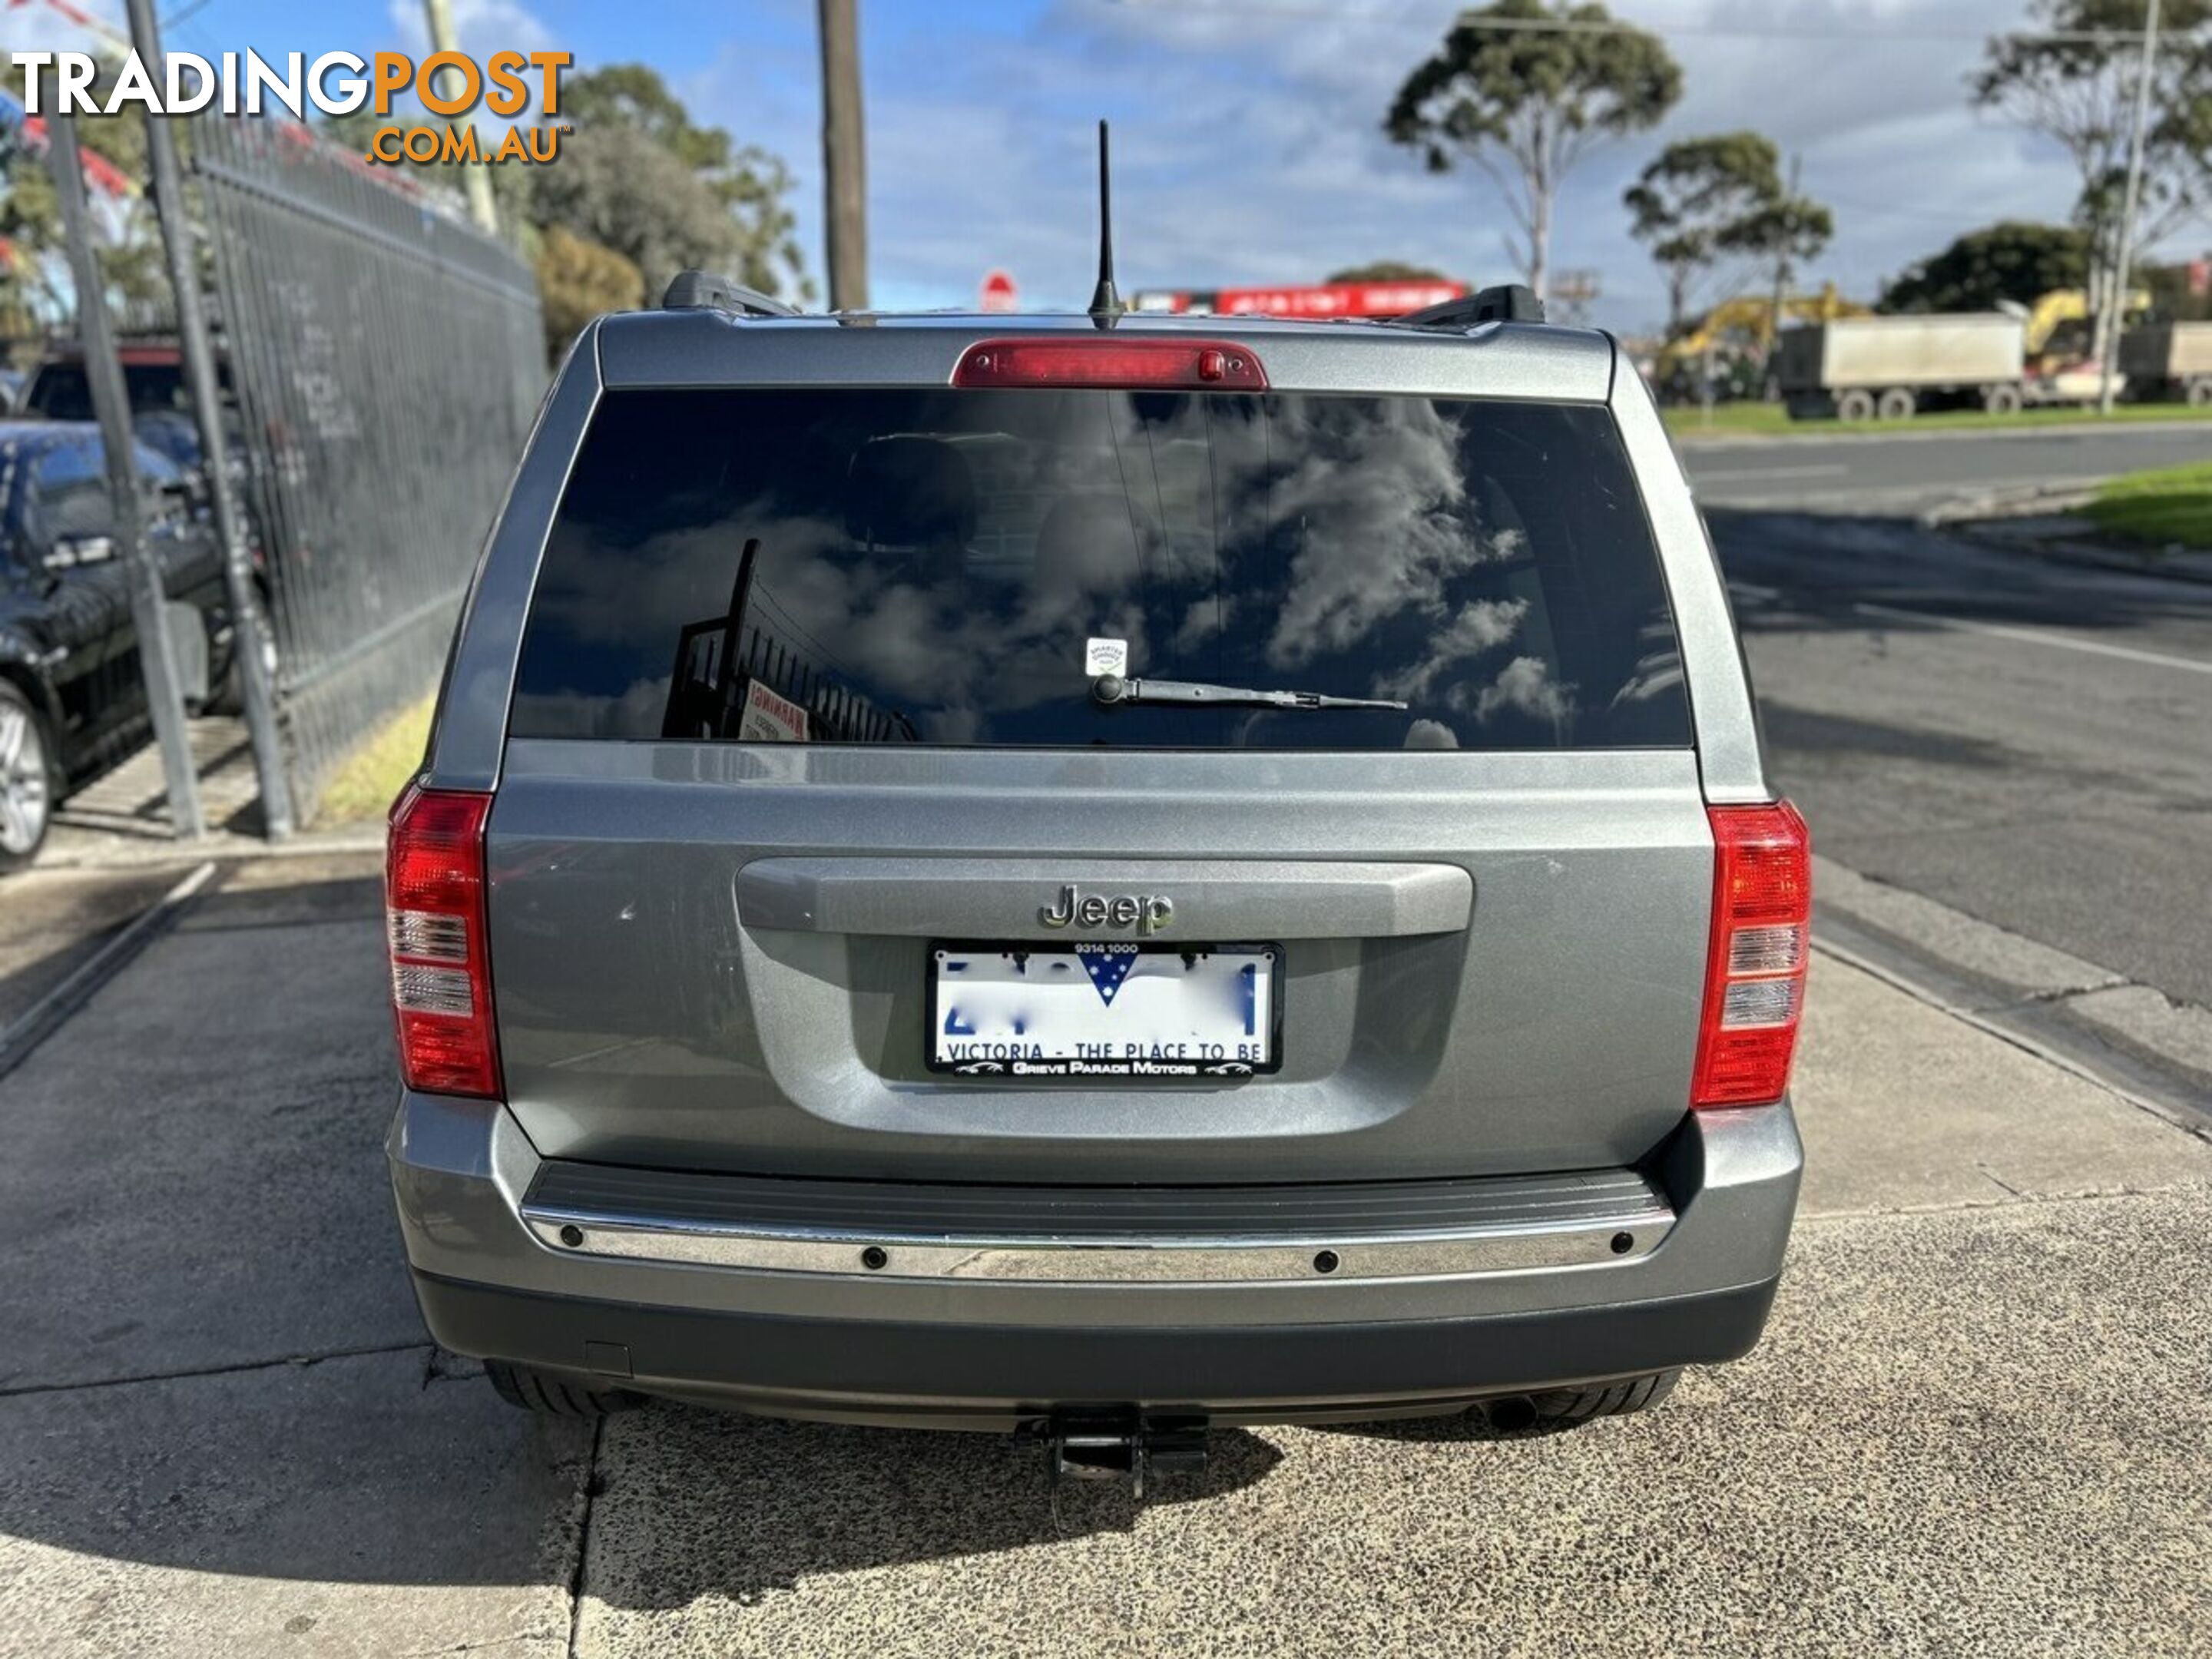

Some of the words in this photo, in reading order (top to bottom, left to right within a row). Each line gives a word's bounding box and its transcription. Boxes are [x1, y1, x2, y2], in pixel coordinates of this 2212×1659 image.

[1038, 885, 1174, 935] Jeep
[1075, 944, 1104, 953] 9314
[1107, 944, 1137, 953] 1000
[948, 1044, 1043, 1059] VICTORIA
[1075, 1044, 1112, 1058] THE
[1126, 1044, 1186, 1058] PLACE
[1199, 1044, 1224, 1059] TO
[1238, 1044, 1260, 1060] BE
[1012, 1061, 1065, 1074] GRIEVE
[1069, 1061, 1129, 1074] PARADE
[1133, 1061, 1197, 1074] MOTORS
